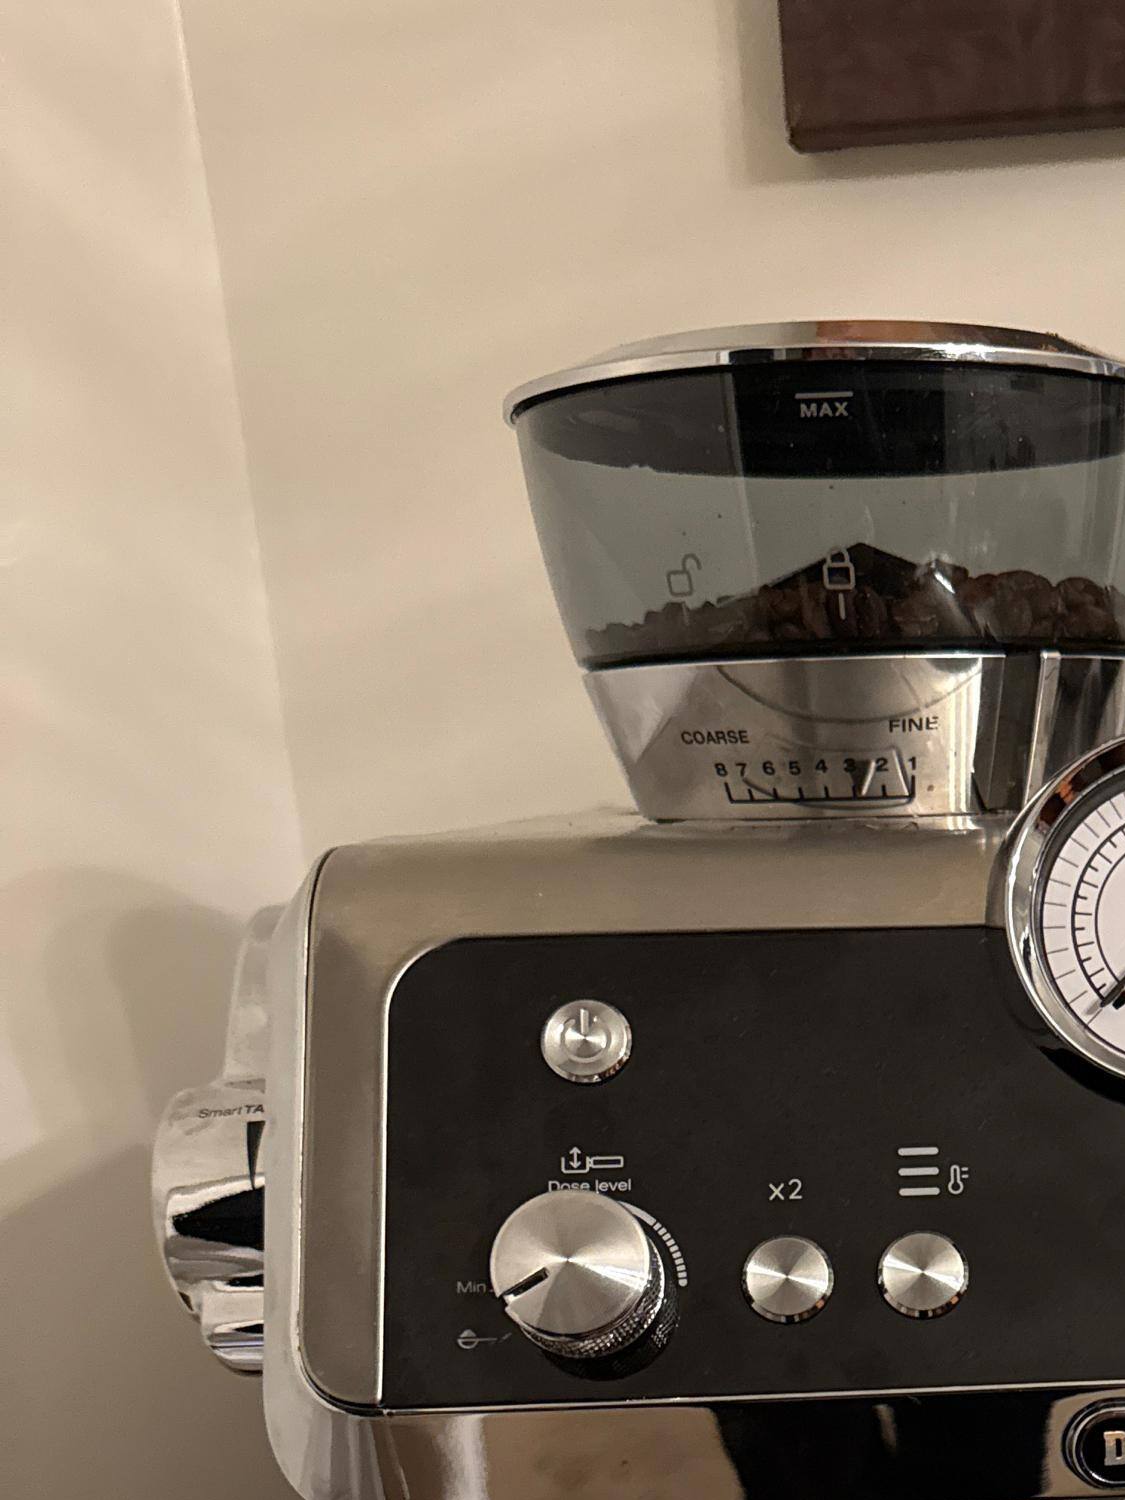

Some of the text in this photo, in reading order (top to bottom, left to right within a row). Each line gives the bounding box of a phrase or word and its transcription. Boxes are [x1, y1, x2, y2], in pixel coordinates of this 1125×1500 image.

[799, 402, 849, 418] MAX
[888, 716, 938, 733] FINE
[680, 729, 750, 745] COARSE
[714, 756, 918, 778] 8 7 6 5 4 3 2 1
[548, 1178, 632, 1193] Dose level
[456, 1281, 487, 1294] Min
